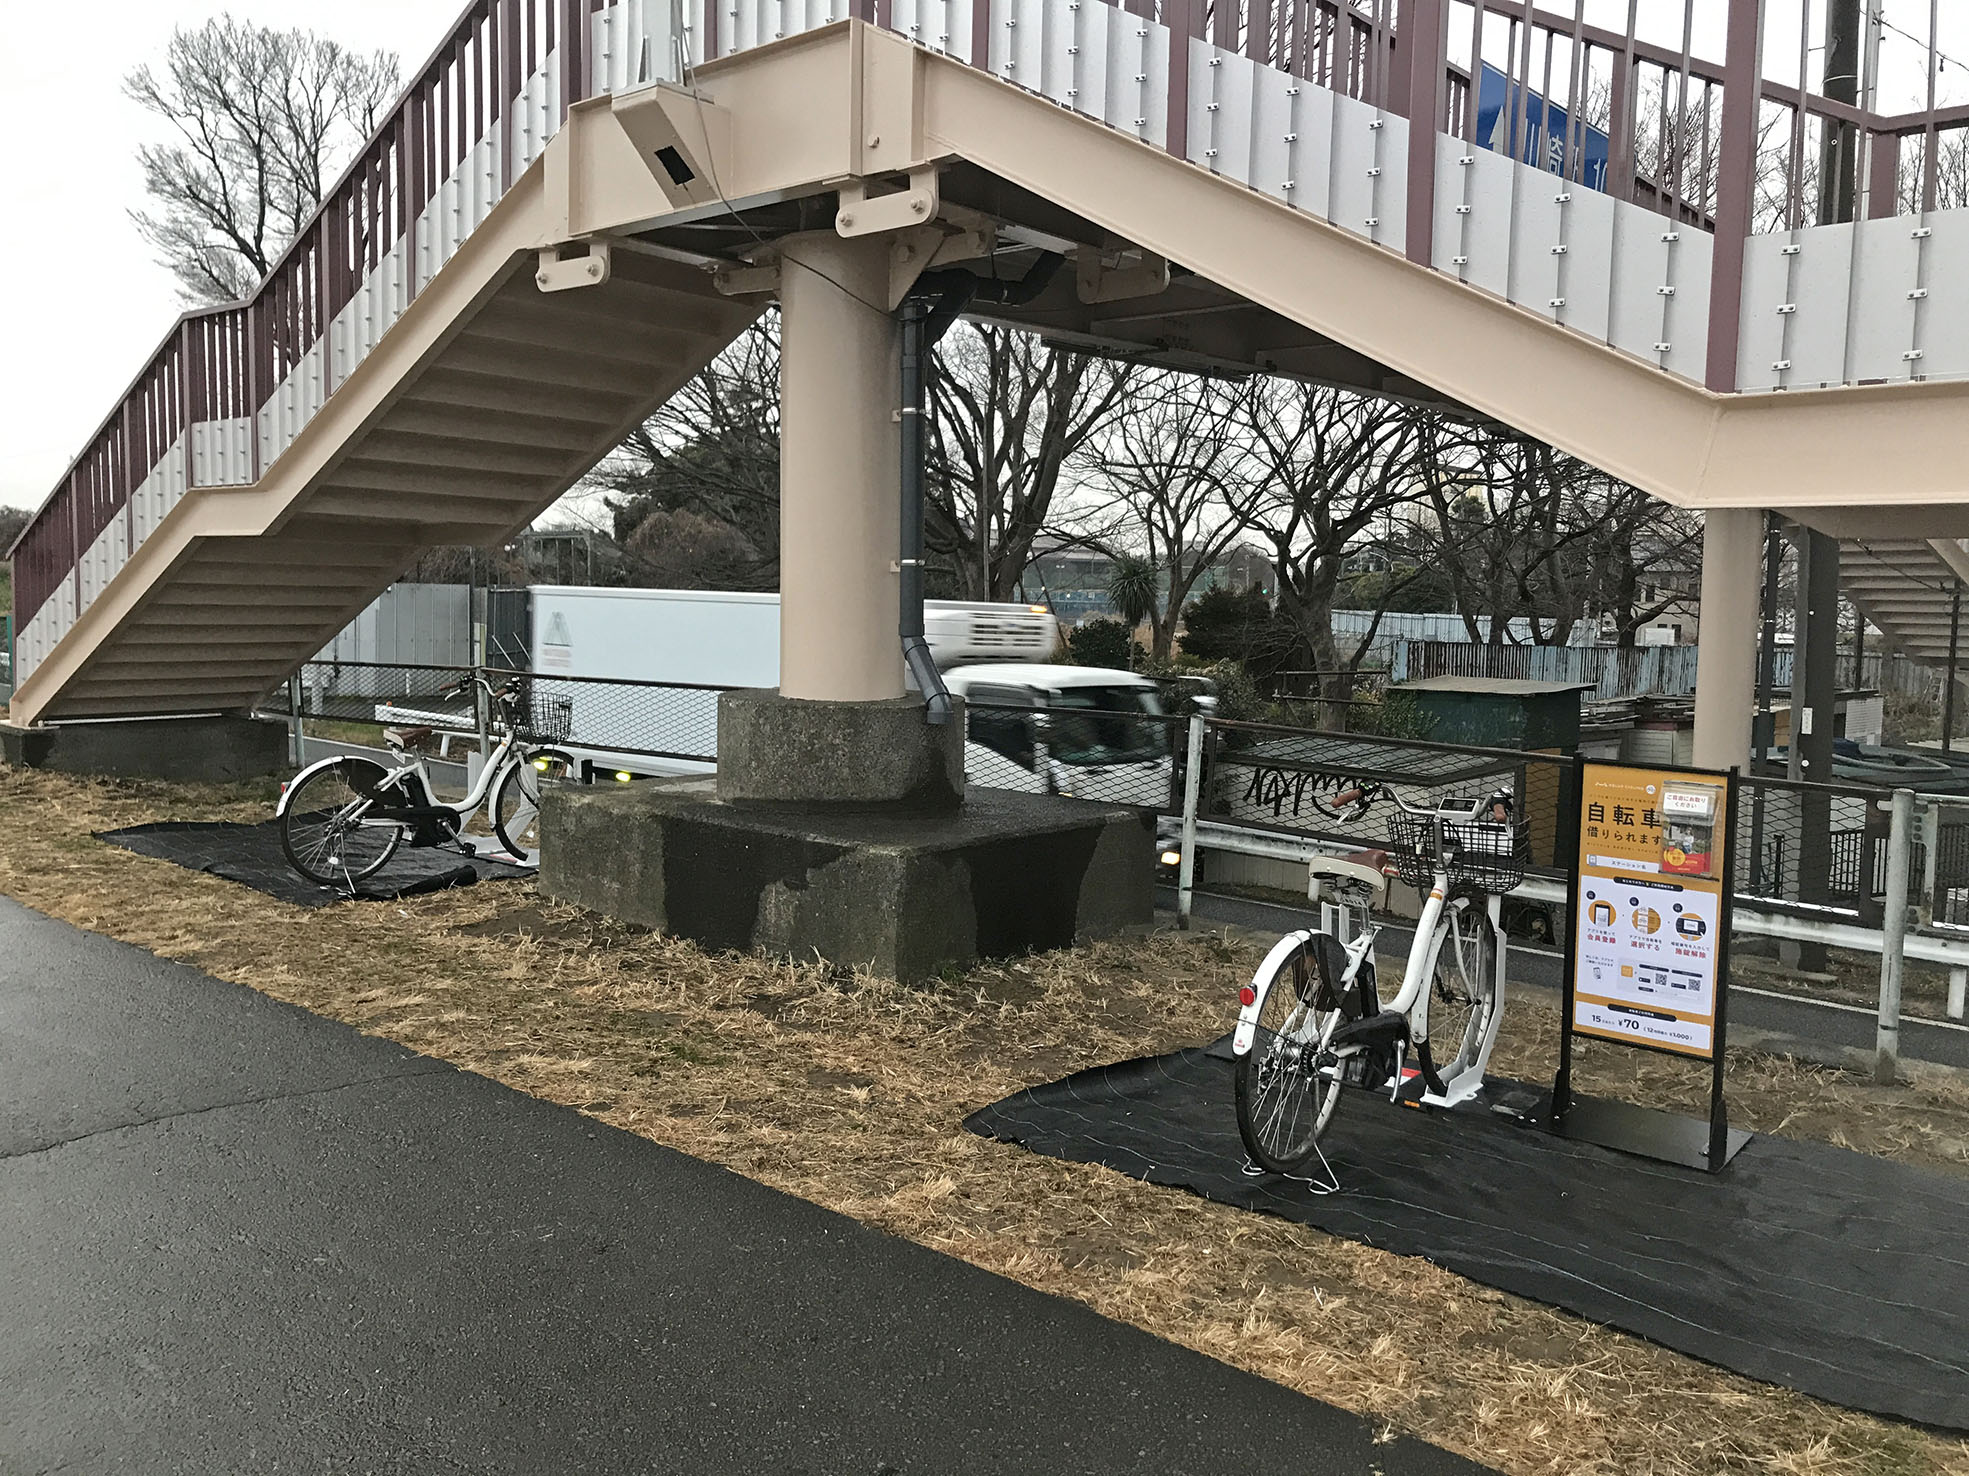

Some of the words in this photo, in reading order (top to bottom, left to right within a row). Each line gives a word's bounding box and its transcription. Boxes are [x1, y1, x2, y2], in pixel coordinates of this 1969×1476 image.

[1588, 801, 1662, 829] 自転車
[1587, 825, 1661, 846] 借りられます
[1631, 940, 1660, 951] 選択する
[1618, 1018, 1640, 1030] ¥70
